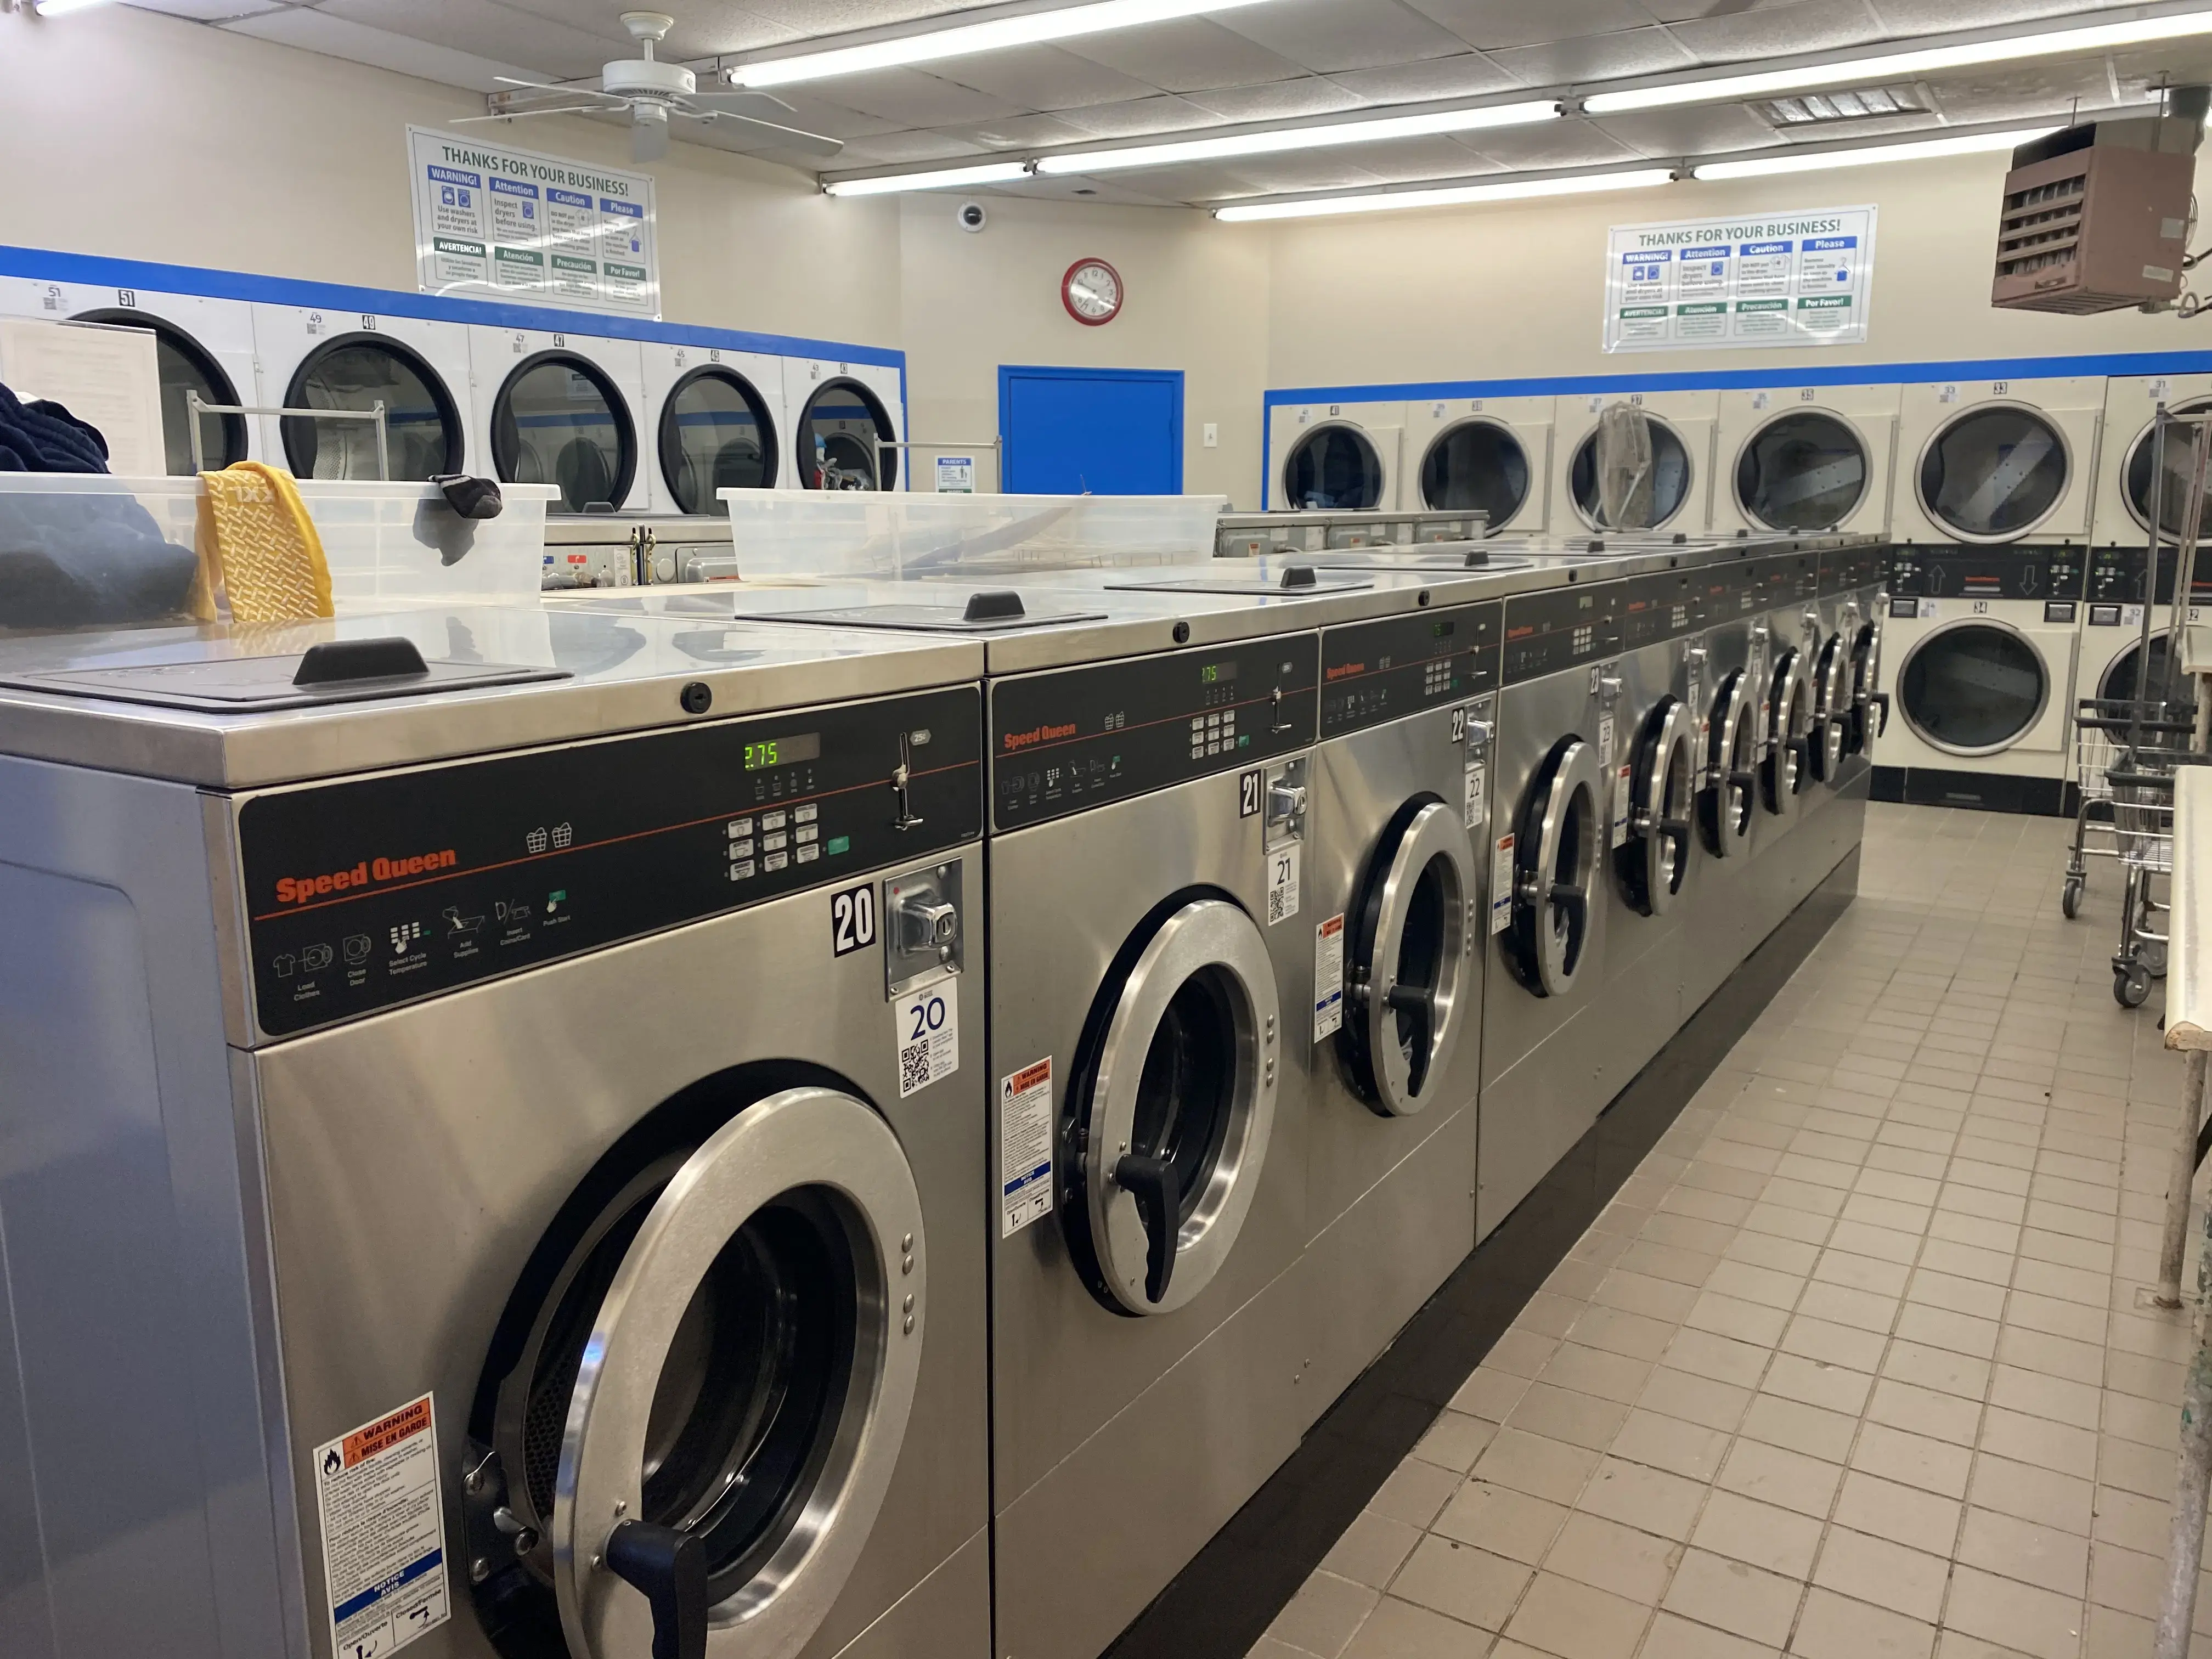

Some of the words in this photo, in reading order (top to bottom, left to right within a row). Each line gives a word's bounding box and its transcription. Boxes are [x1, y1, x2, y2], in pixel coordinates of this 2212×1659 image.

[431, 167, 477, 185] WARNING!
[442, 145, 498, 171] THANKS
[502, 158, 528, 176] FOR
[530, 163, 565, 183] YOUR
[568, 171, 628, 196] BUSINESS!
[494, 180, 533, 196] Attention
[494, 198, 517, 210] Inspect
[555, 191, 585, 206] Caution
[438, 205, 448, 213] Use
[450, 207, 475, 218] washers
[494, 207, 515, 219] dryers
[611, 202, 633, 215] Please
[437, 213, 449, 221] and
[450, 215, 470, 225] dryers
[495, 216, 516, 227] before
[517, 221, 537, 232] using.
[437, 222, 450, 230] your
[467, 225, 478, 234] risk
[1639, 230, 1692, 246] THANKS
[1696, 228, 1723, 241] FOR
[1725, 225, 1764, 239] YOUR
[1767, 219, 1841, 236] BUSINESS!
[1749, 244, 1784, 253] Caution
[1815, 239, 1845, 249] Please
[503, 250, 534, 262] Atención
[1626, 252, 1669, 263] WARNING!
[1685, 248, 1726, 258] Attention
[556, 258, 592, 271] Precaución
[610, 267, 620, 275] Por
[48, 287, 61, 297] 51
[120, 290, 134, 306] 51
[310, 314, 321, 323] 49
[363, 315, 375, 329] 49
[516, 334, 524, 343] 47
[555, 335, 563, 346] 47
[1452, 709, 1464, 742] 22
[1004, 730, 1040, 751] Speed
[1041, 723, 1076, 741] Queen
[1603, 725, 1611, 742] 23
[1243, 773, 1258, 815] 21
[1470, 777, 1480, 799] 22
[276, 861, 368, 904] Speed
[371, 849, 456, 881] Queen
[1277, 857, 1291, 885] 21
[835, 888, 873, 952] 20
[389, 957, 408, 967] Select
[409, 953, 426, 962] Cycle
[388, 961, 427, 976] Temperature
[910, 997, 945, 1041] 20
[1022, 1062, 1047, 1080] WARNING
[363, 1404, 422, 1441] WARNING
[361, 1438, 383, 1458] MISE
[385, 1431, 397, 1445] EN
[398, 1415, 427, 1438] GARDE
[374, 1570, 404, 1593] NOTICE
[380, 1580, 399, 1597] AVIS
[343, 1618, 387, 1652] Open/Ouverte
